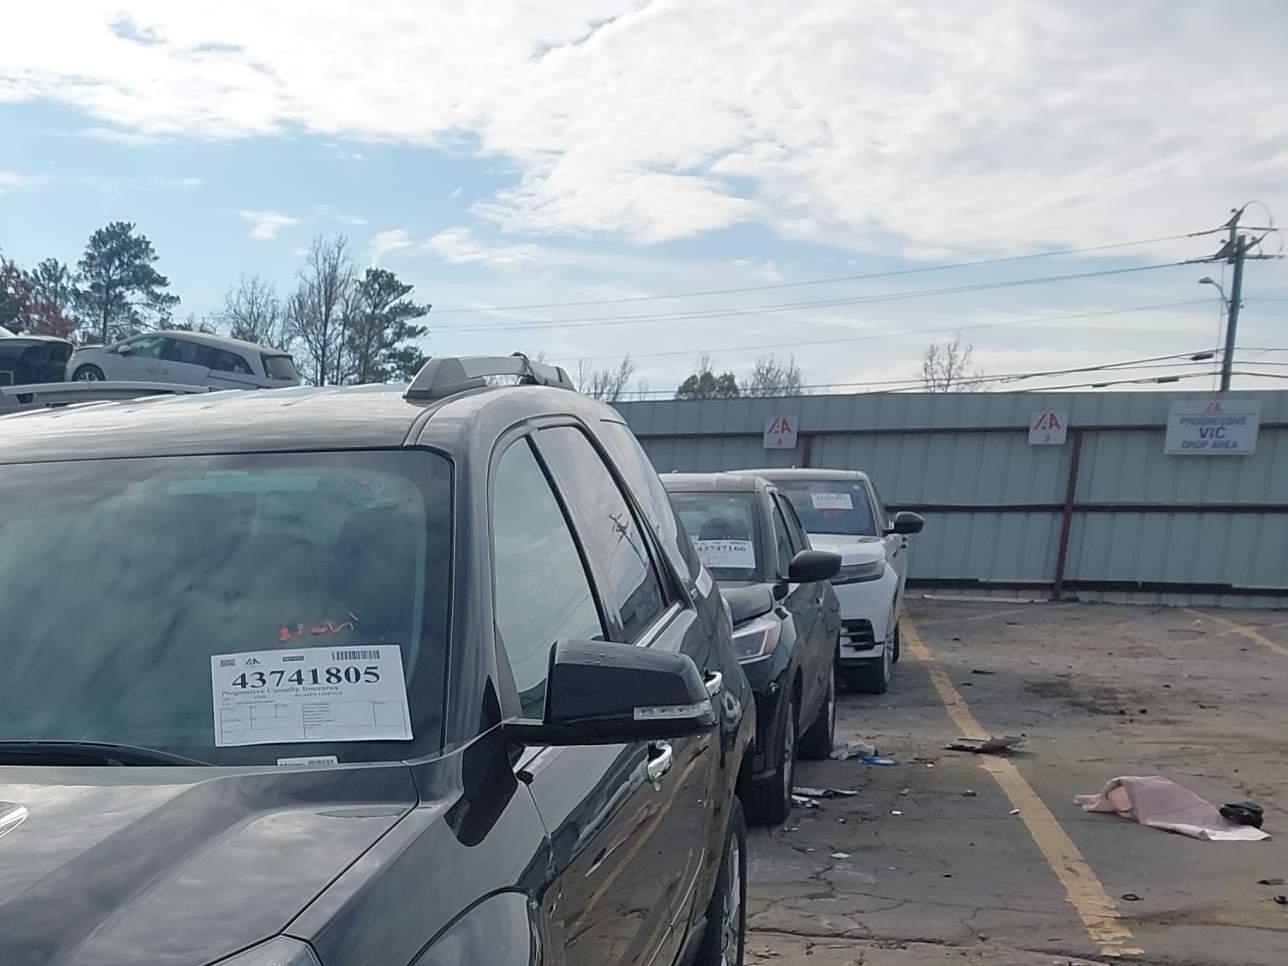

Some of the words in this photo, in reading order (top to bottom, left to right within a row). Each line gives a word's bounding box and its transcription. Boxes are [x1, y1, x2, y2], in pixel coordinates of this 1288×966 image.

[1180, 416, 1247, 425] PROGRESSIVE
[1199, 426, 1226, 439] VIC
[1182, 440, 1208, 449] DROP
[1212, 440, 1238, 449] AREA
[232, 666, 380, 689] 43741805
[302, 684, 339, 692] Insurance
